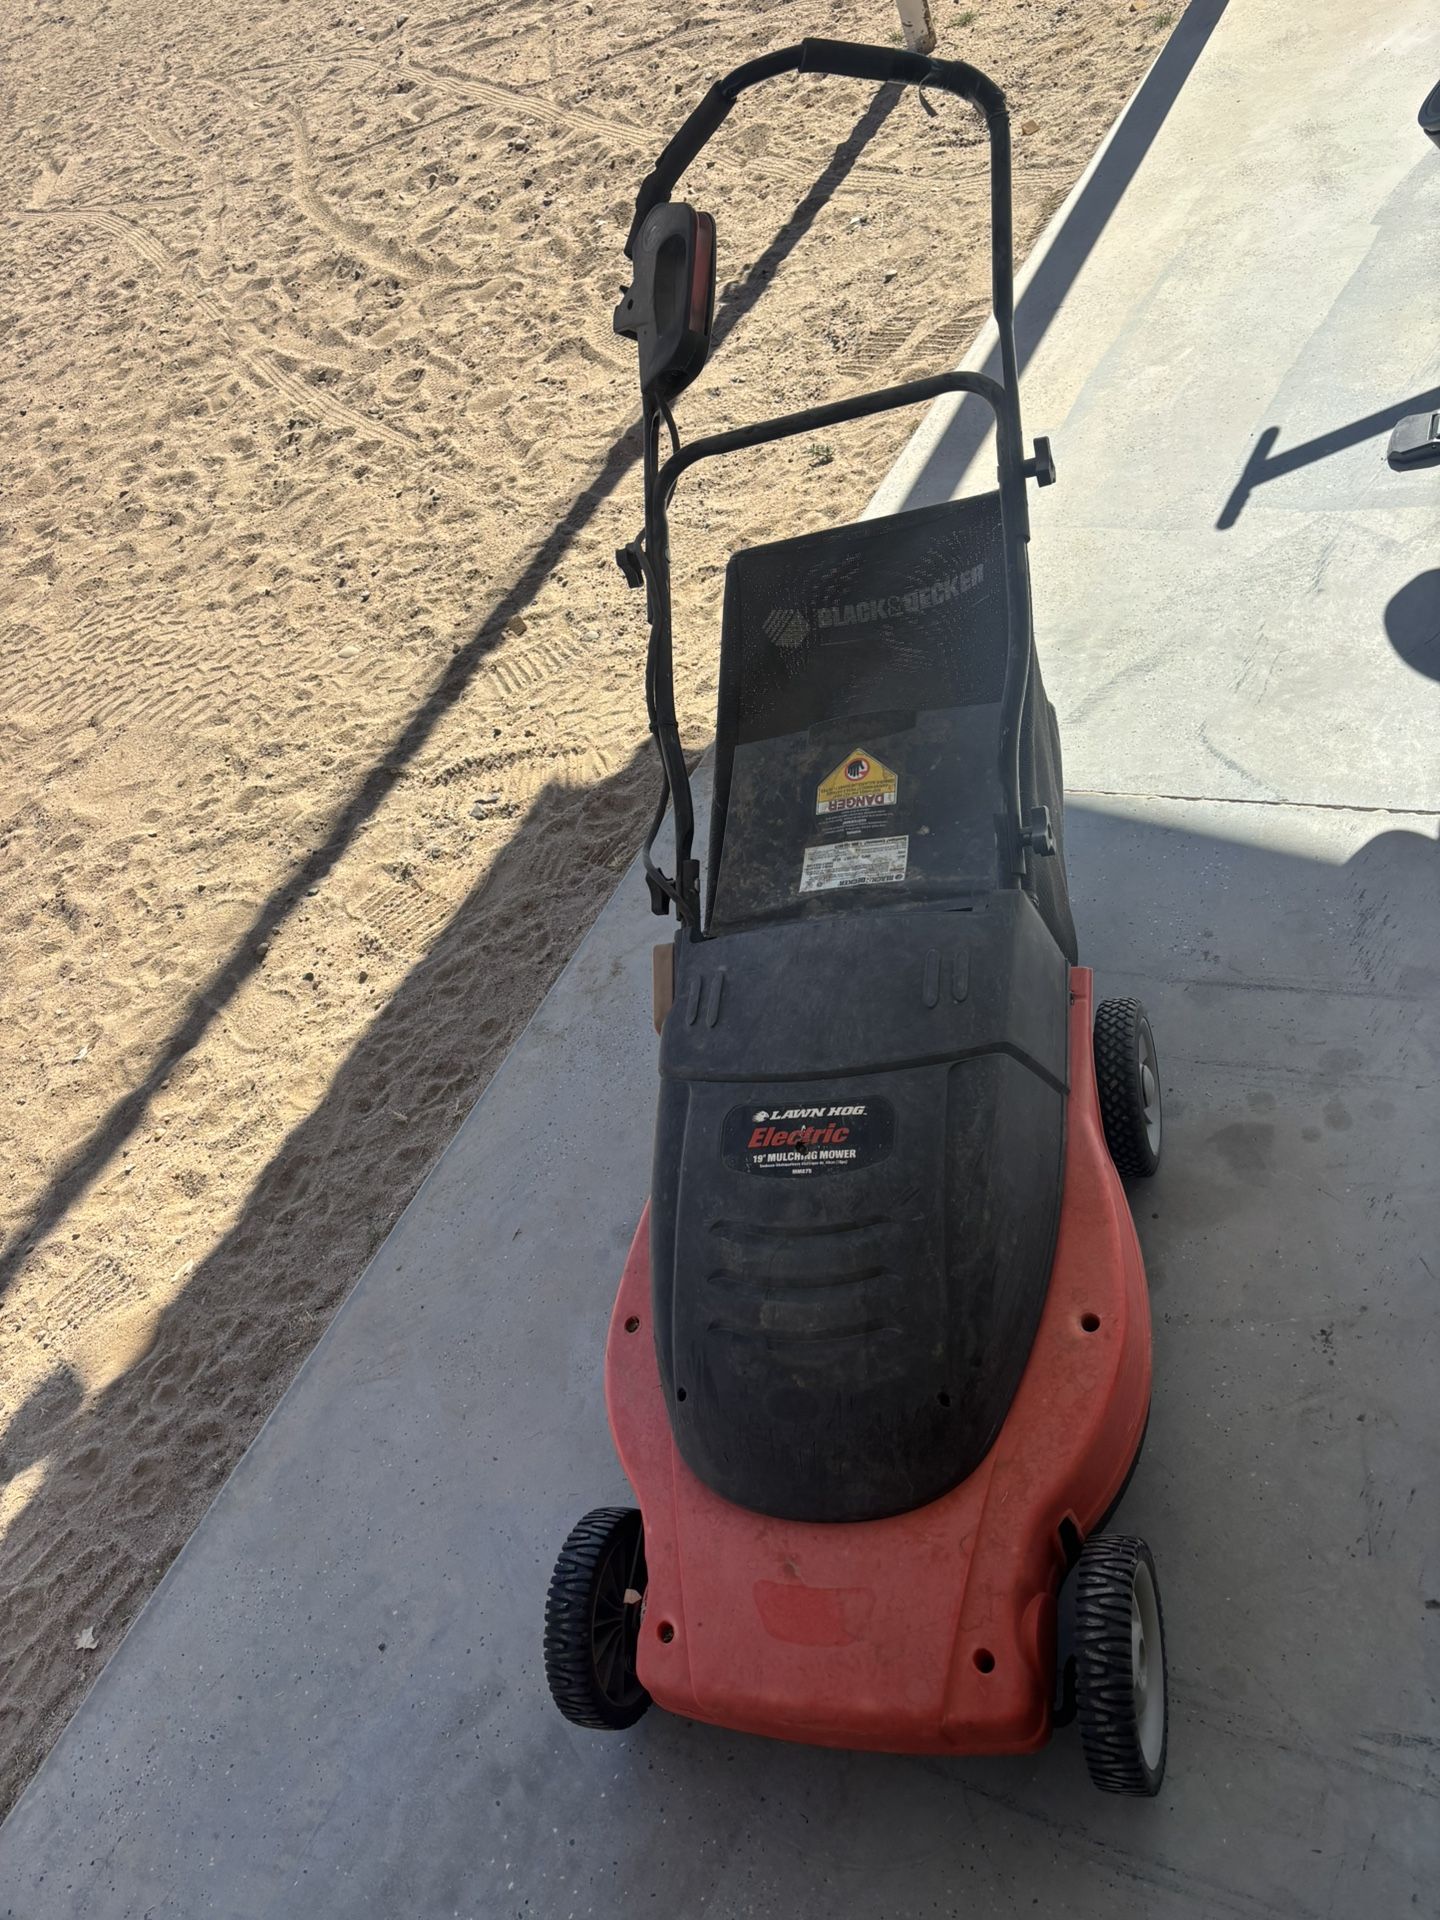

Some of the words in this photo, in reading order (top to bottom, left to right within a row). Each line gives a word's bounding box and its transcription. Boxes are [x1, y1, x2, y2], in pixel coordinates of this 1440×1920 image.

[828, 795, 884, 810] DANGER
[770, 1107, 825, 1120] LAWN
[828, 1105, 865, 1116] HOG
[748, 1123, 849, 1148] Electric
[820, 1150, 856, 1160] MOWER
